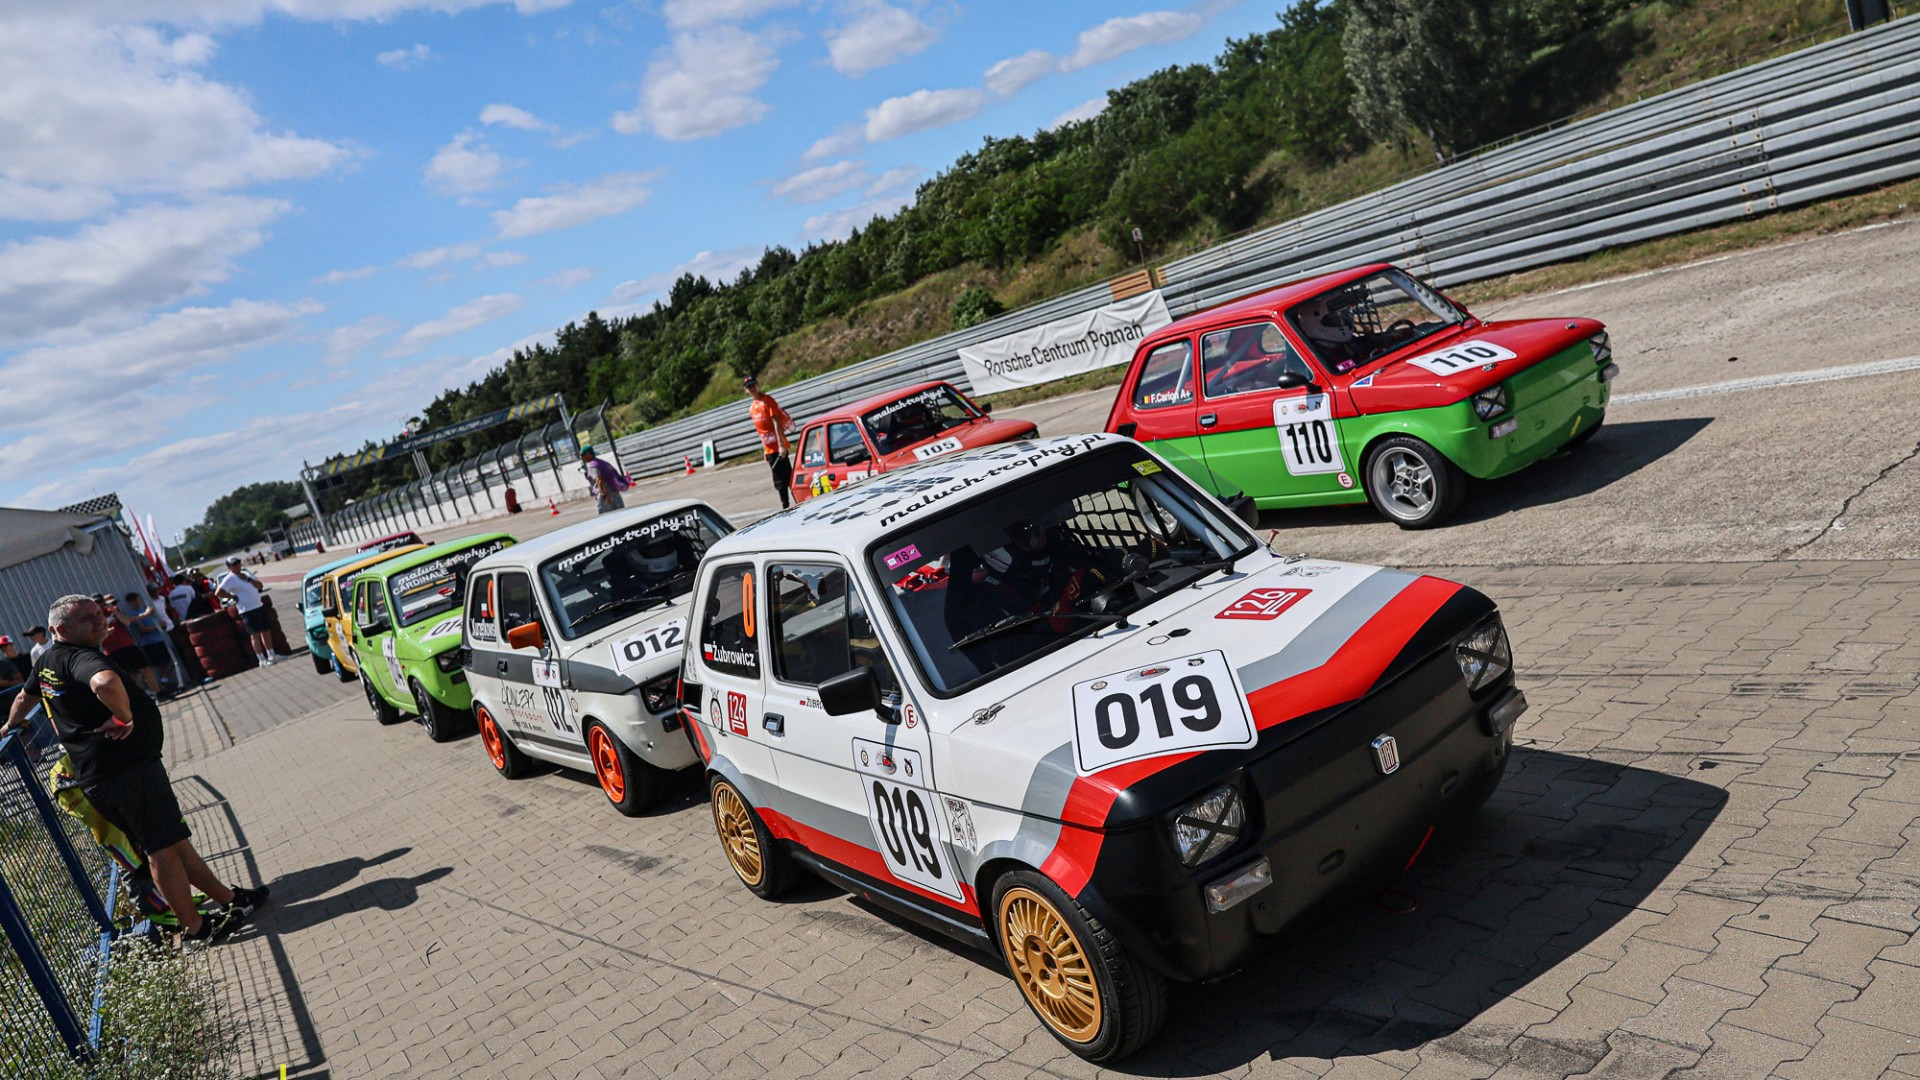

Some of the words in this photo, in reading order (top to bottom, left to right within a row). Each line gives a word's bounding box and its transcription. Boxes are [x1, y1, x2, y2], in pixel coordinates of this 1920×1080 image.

[984, 353, 1033, 377] Porsche
[1032, 338, 1090, 365] Centrum
[1087, 319, 1144, 350] Poznań
[1431, 346, 1498, 368] 110
[873, 386, 946, 421] maluch-trophy.pl
[920, 440, 956, 457] 105
[1287, 420, 1332, 465] 110
[880, 434, 1106, 528] maluch-trophy.pl
[558, 509, 700, 571] maluch-trophy.pl
[894, 551, 910, 563] 18
[392, 568, 449, 595] CARDINALE
[398, 541, 501, 585] maluch-trophy.pl
[624, 627, 684, 662] 012
[713, 641, 755, 666] Żubrowicz
[543, 686, 575, 733] 012
[1095, 675, 1222, 750] 019
[873, 780, 942, 879] 019
